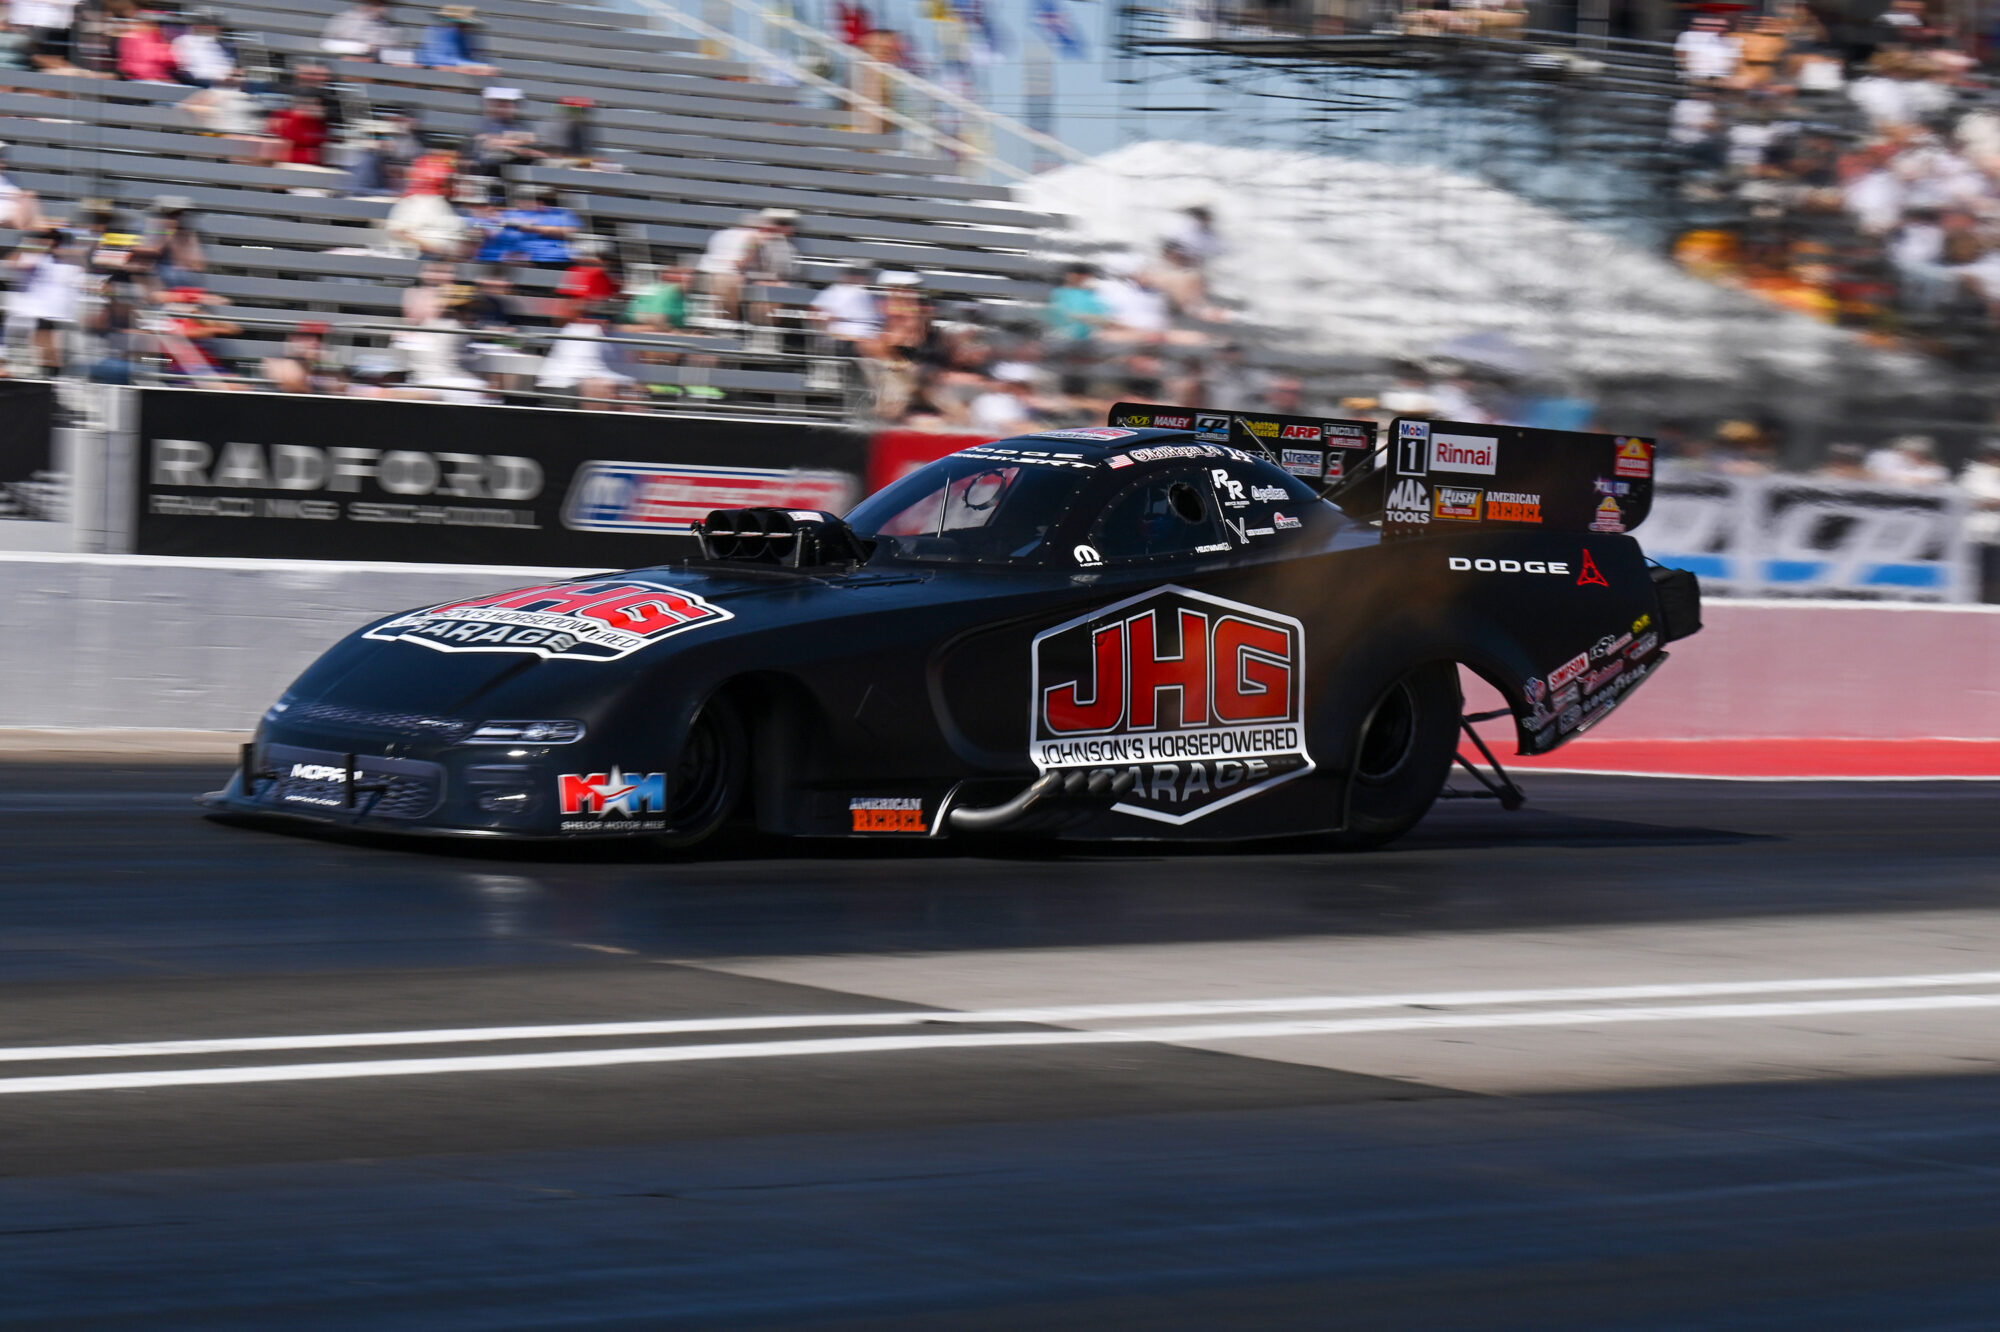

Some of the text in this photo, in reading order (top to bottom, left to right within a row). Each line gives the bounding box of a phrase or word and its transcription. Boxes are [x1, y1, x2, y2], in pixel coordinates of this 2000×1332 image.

[1154, 415, 1190, 427] MANLEY
[1324, 424, 1361, 436] LINCOLN
[1401, 423, 1428, 437] Mobil
[1283, 425, 1320, 438] ARP
[965, 446, 1084, 460] DODGE
[1407, 441, 1416, 470] 1
[1436, 443, 1492, 466] Rinnai
[151, 438, 545, 500] RADFORD
[1386, 478, 1431, 511] MAC
[1439, 488, 1477, 508] RUSH
[1486, 491, 1541, 505] AMERICAN
[1385, 510, 1430, 524] TOOLS
[1486, 501, 1543, 524] REBEL
[1448, 556, 1570, 575] DODGE
[1044, 607, 1292, 737] JHG
[1550, 655, 1587, 690] SIMPSON
[1039, 727, 1298, 766] JOHNSON'S HORSEPOWERED
[849, 797, 922, 811] AMERICAN
[603, 821, 641, 830] MOTOR
[852, 809, 928, 832] REBEL
